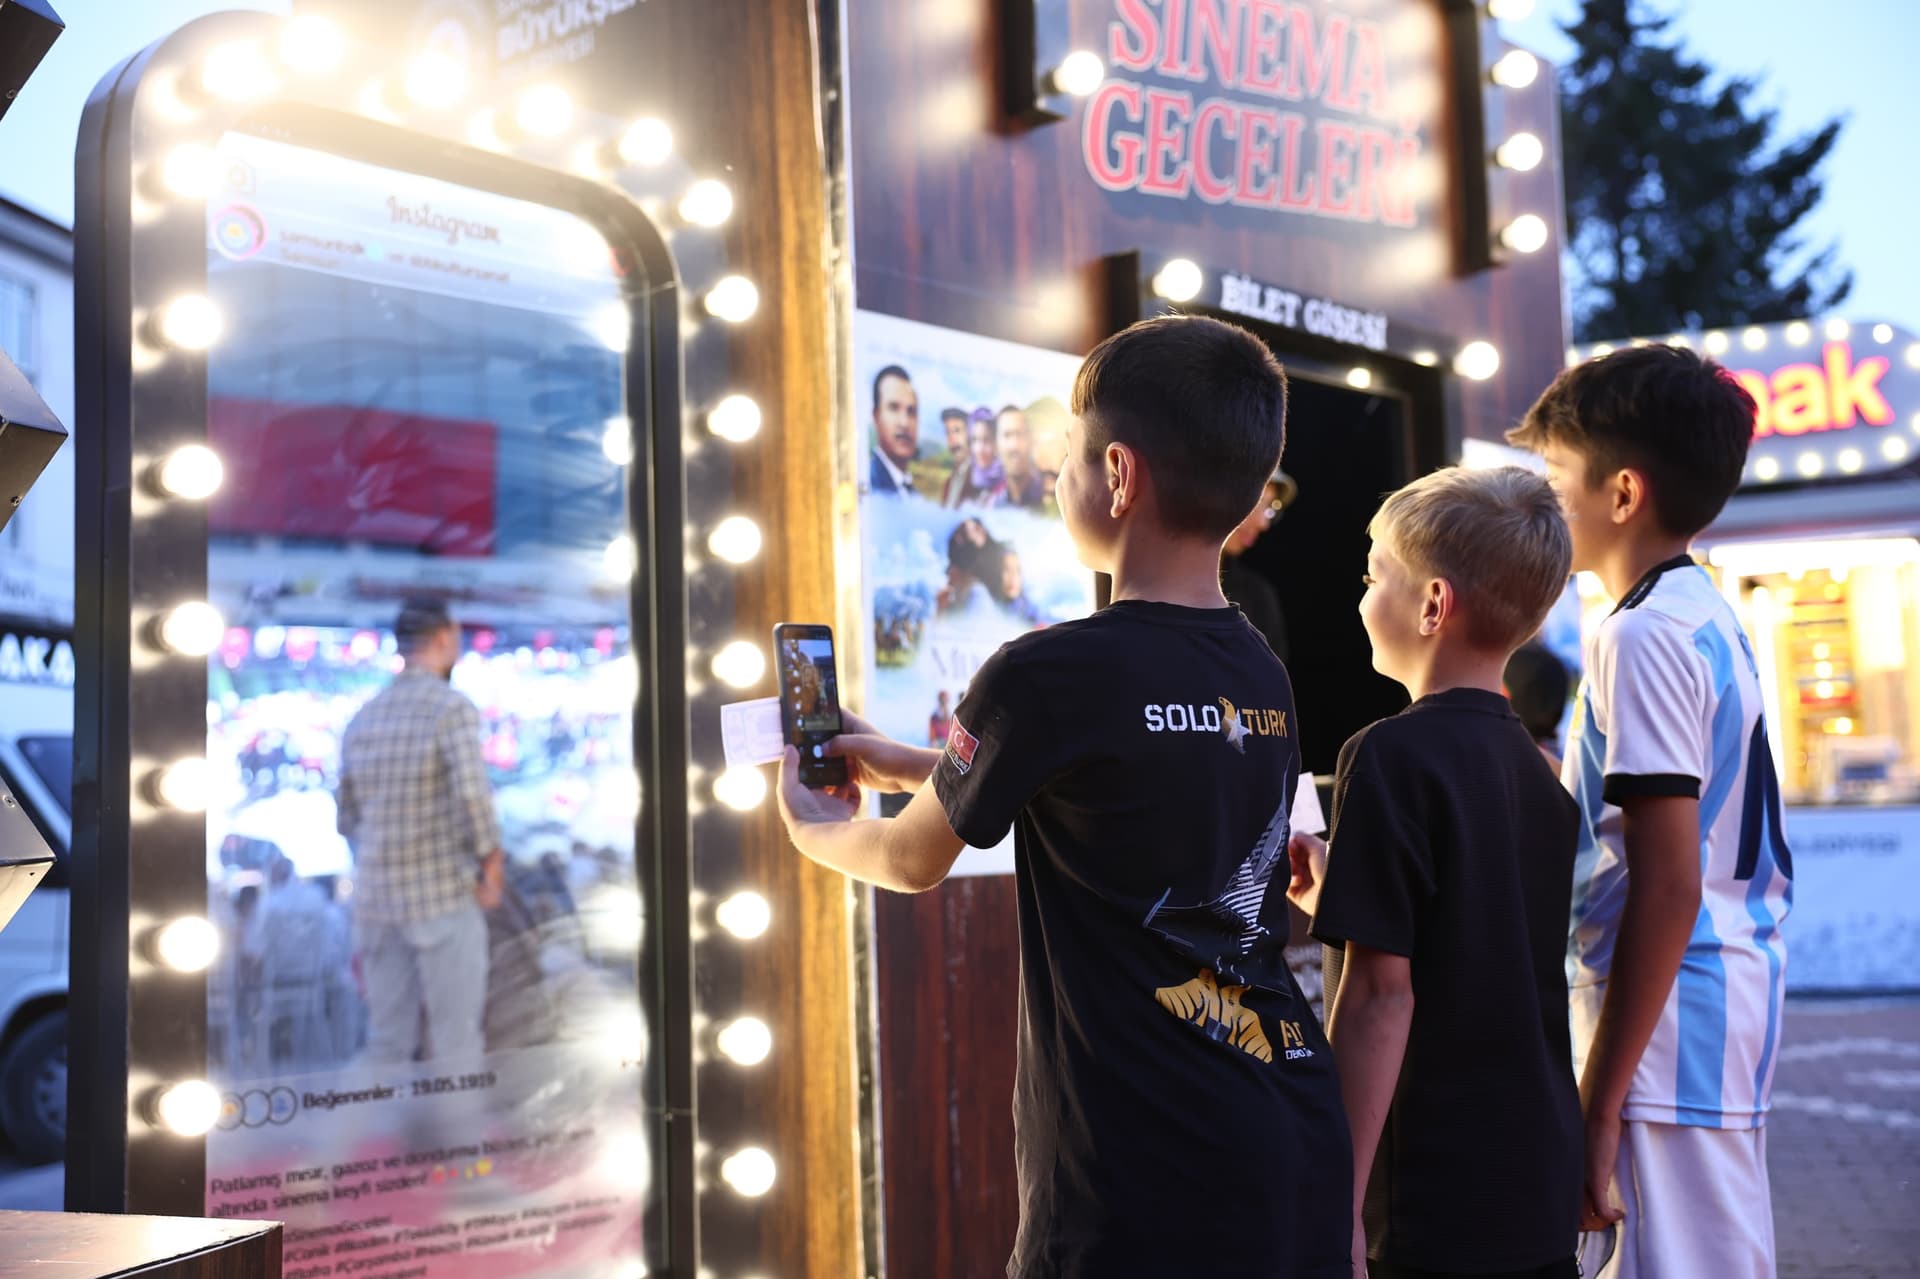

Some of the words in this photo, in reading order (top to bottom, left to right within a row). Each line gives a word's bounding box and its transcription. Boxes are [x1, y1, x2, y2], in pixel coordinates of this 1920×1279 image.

[1082, 79, 1420, 228] GECELERİ
[1220, 272, 1301, 328] BİLET
[1144, 703, 1221, 733] SOLO
[1242, 707, 1288, 739] TÜRK
[303, 1084, 395, 1110] Beğenenler
[411, 1070, 498, 1096] 19.05.1919
[210, 1172, 281, 1194] Patlamış
[332, 1157, 379, 1179] gazoz
[384, 1155, 401, 1169] ve
[273, 1188, 330, 1209] sinema
